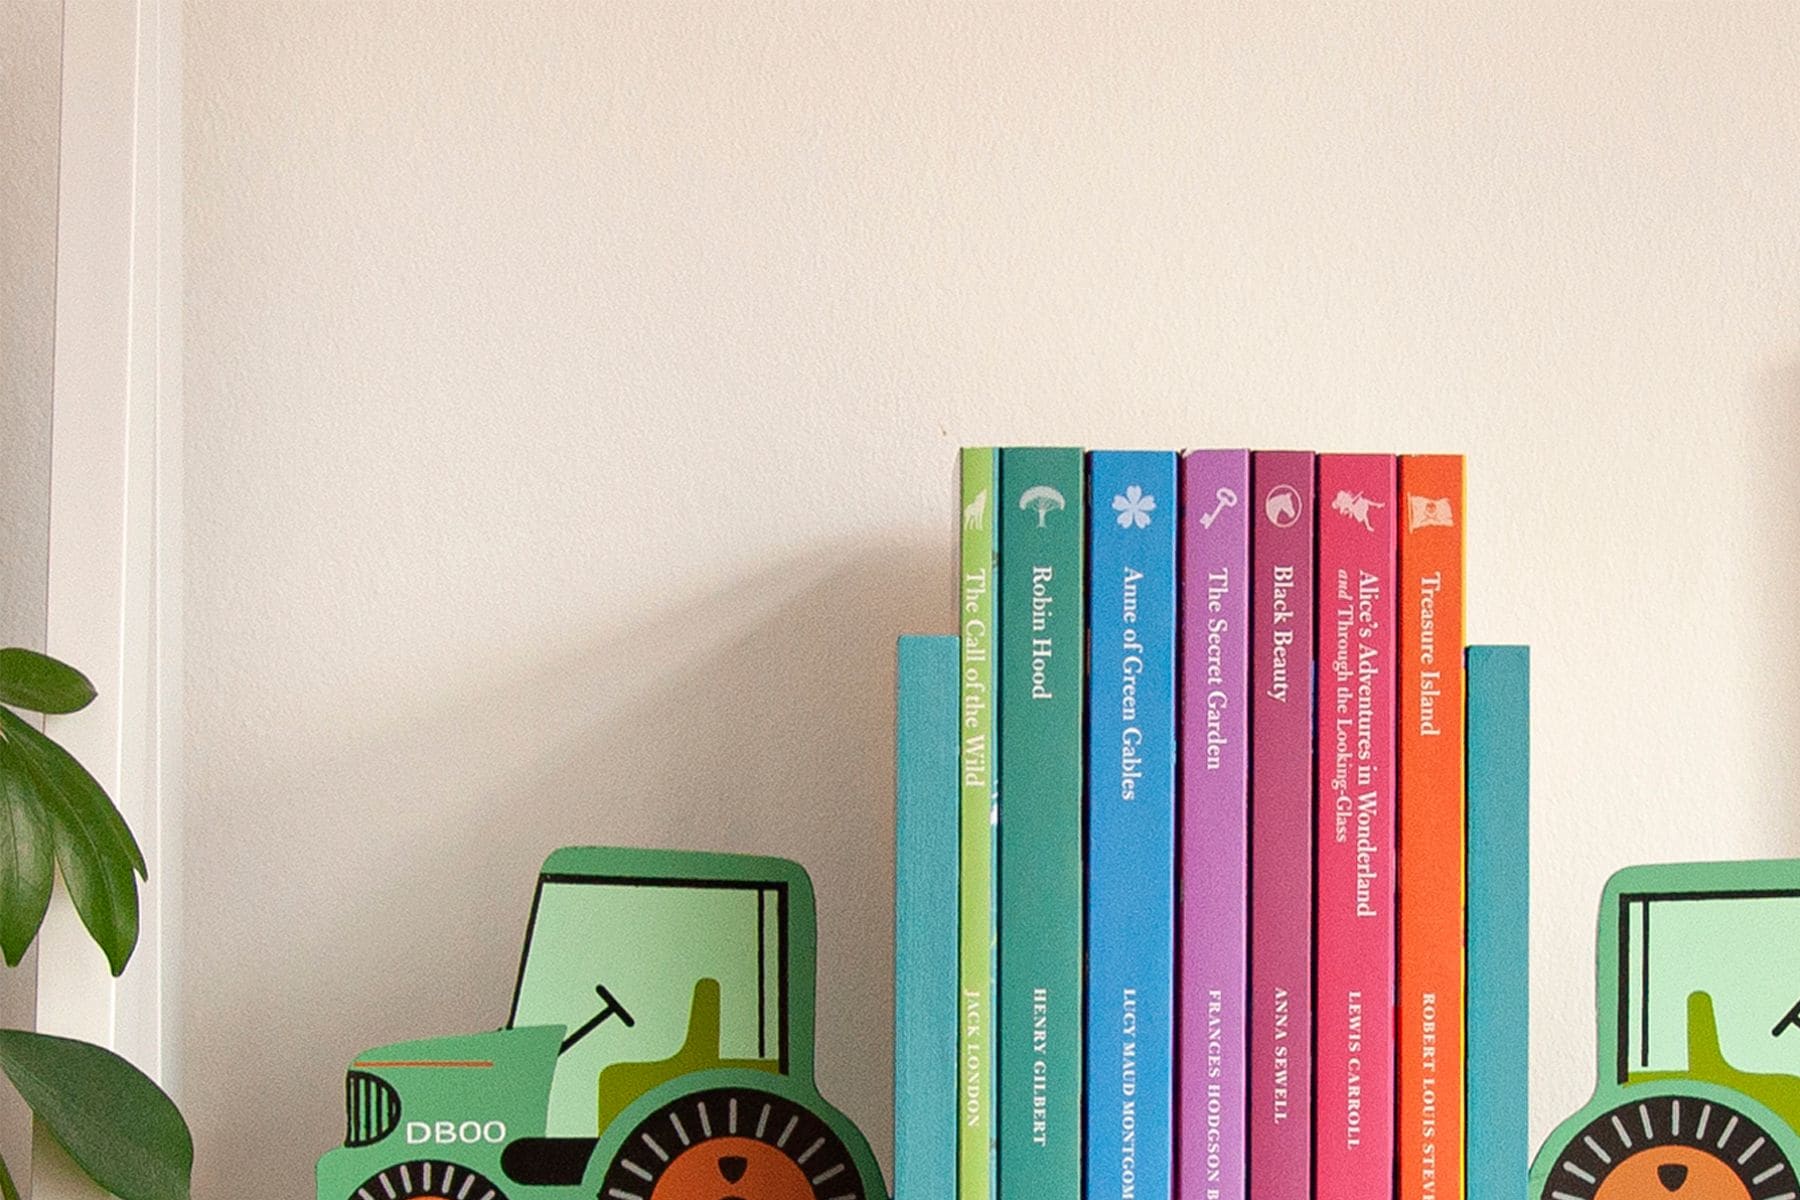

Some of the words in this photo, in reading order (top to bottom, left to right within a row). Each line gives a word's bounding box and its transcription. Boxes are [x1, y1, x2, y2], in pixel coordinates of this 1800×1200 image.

[967, 568, 986, 612] The
[1032, 565, 1053, 631] Robin
[1123, 566, 1144, 623] Anne
[1208, 567, 1229, 613] The
[1273, 565, 1294, 625] Black
[1338, 569, 1353, 601] and
[967, 619, 986, 661] Call
[1123, 628, 1143, 654] of
[1332, 604, 1353, 682] Through
[1420, 571, 1441, 665] Treasure
[966, 668, 986, 693] of
[1031, 637, 1052, 700] Hood
[1208, 618, 1228, 685] Secret
[1268, 630, 1294, 703] Beauty
[966, 688, 986, 728] the
[1122, 655, 1143, 721] Green
[1337, 686, 1353, 714] the
[1357, 643, 1379, 761] Adventures
[1420, 671, 1441, 736] Island
[965, 734, 986, 787] Wild
[1207, 690, 1228, 770] Garden
[1121, 726, 1143, 801] Gables
[1331, 718, 1353, 843] Looking-Glass
[1357, 765, 1378, 785] in
[1356, 790, 1378, 917] Wonderland
[966, 989, 981, 1037] JACK
[1033, 988, 1047, 1055] HENRY
[1123, 988, 1137, 1037] LUCY
[1208, 990, 1222, 1078] FRANCES
[1274, 987, 1288, 1041] ANNA
[1348, 990, 1362, 1052] LEWIS
[1422, 993, 1436, 1072] ROBERT
[966, 1043, 981, 1128] LONDON
[1122, 1042, 1136, 1097] MAUD
[1274, 1046, 1288, 1124] SEWELL
[1032, 1060, 1047, 1147] GILBERT
[1207, 1084, 1221, 1182] HODGSON
[1347, 1057, 1361, 1150] CARROLL
[1422, 1078, 1436, 1138] LOUIS
